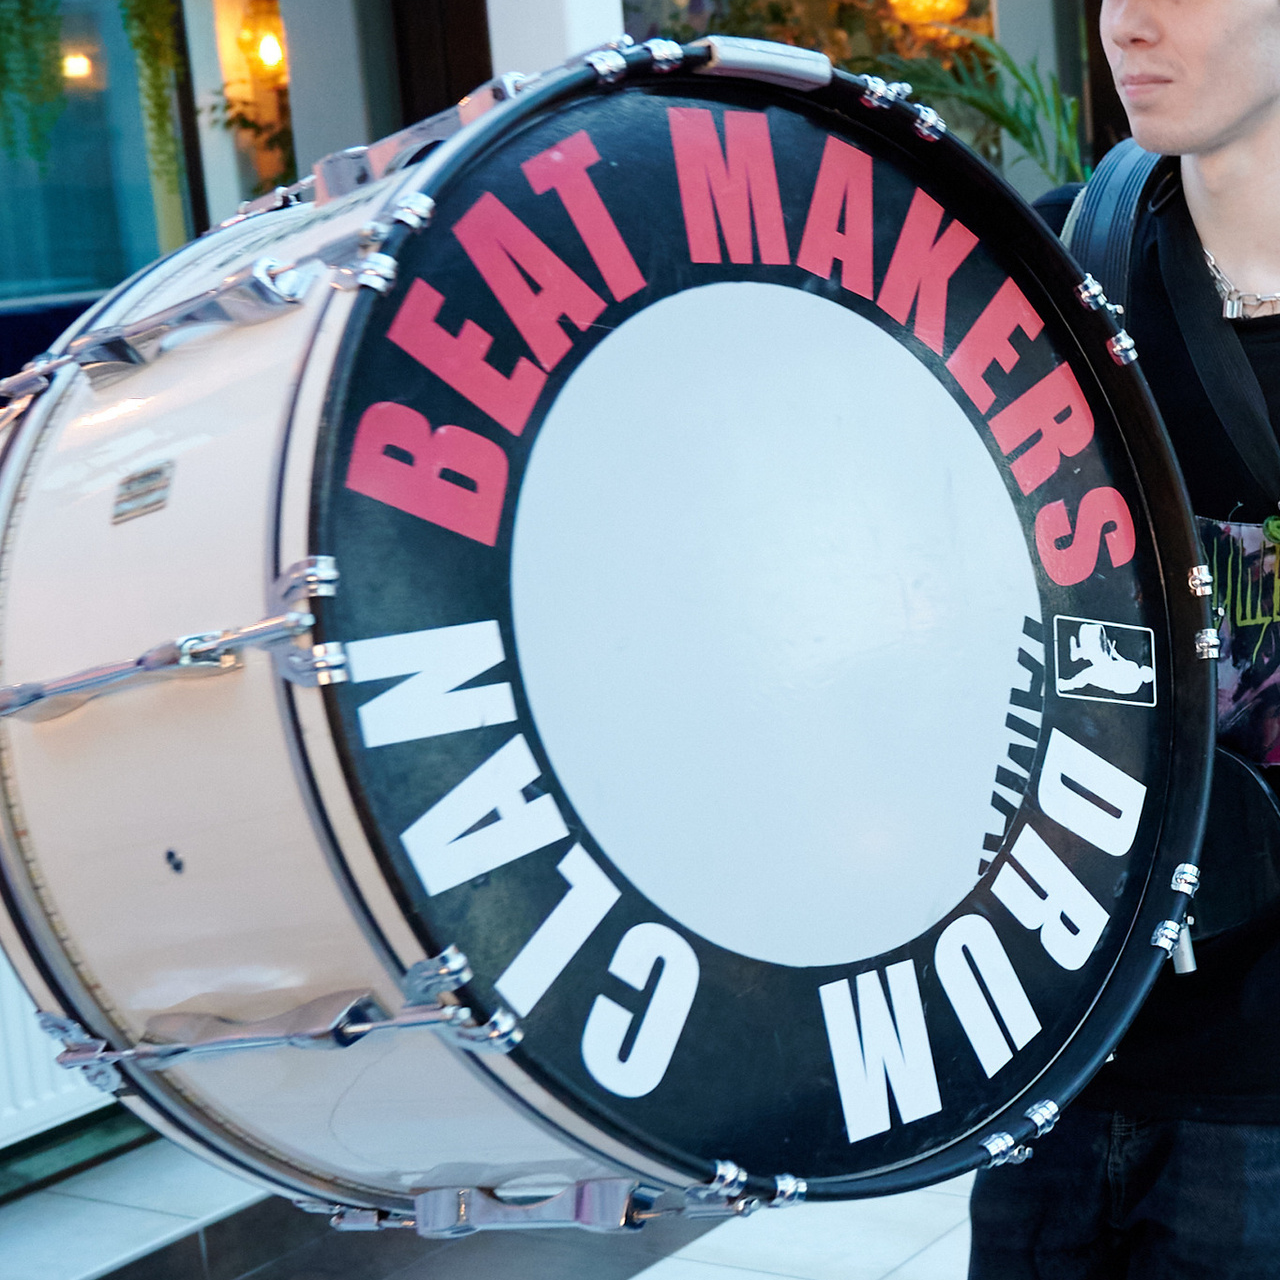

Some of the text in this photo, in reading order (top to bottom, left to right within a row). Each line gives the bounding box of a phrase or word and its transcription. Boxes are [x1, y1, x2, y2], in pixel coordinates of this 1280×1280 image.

[346, 108, 1135, 585] BEAT MAKERS
[347, 621, 699, 1096] CLAN
[820, 728, 1146, 1142] DRUM
